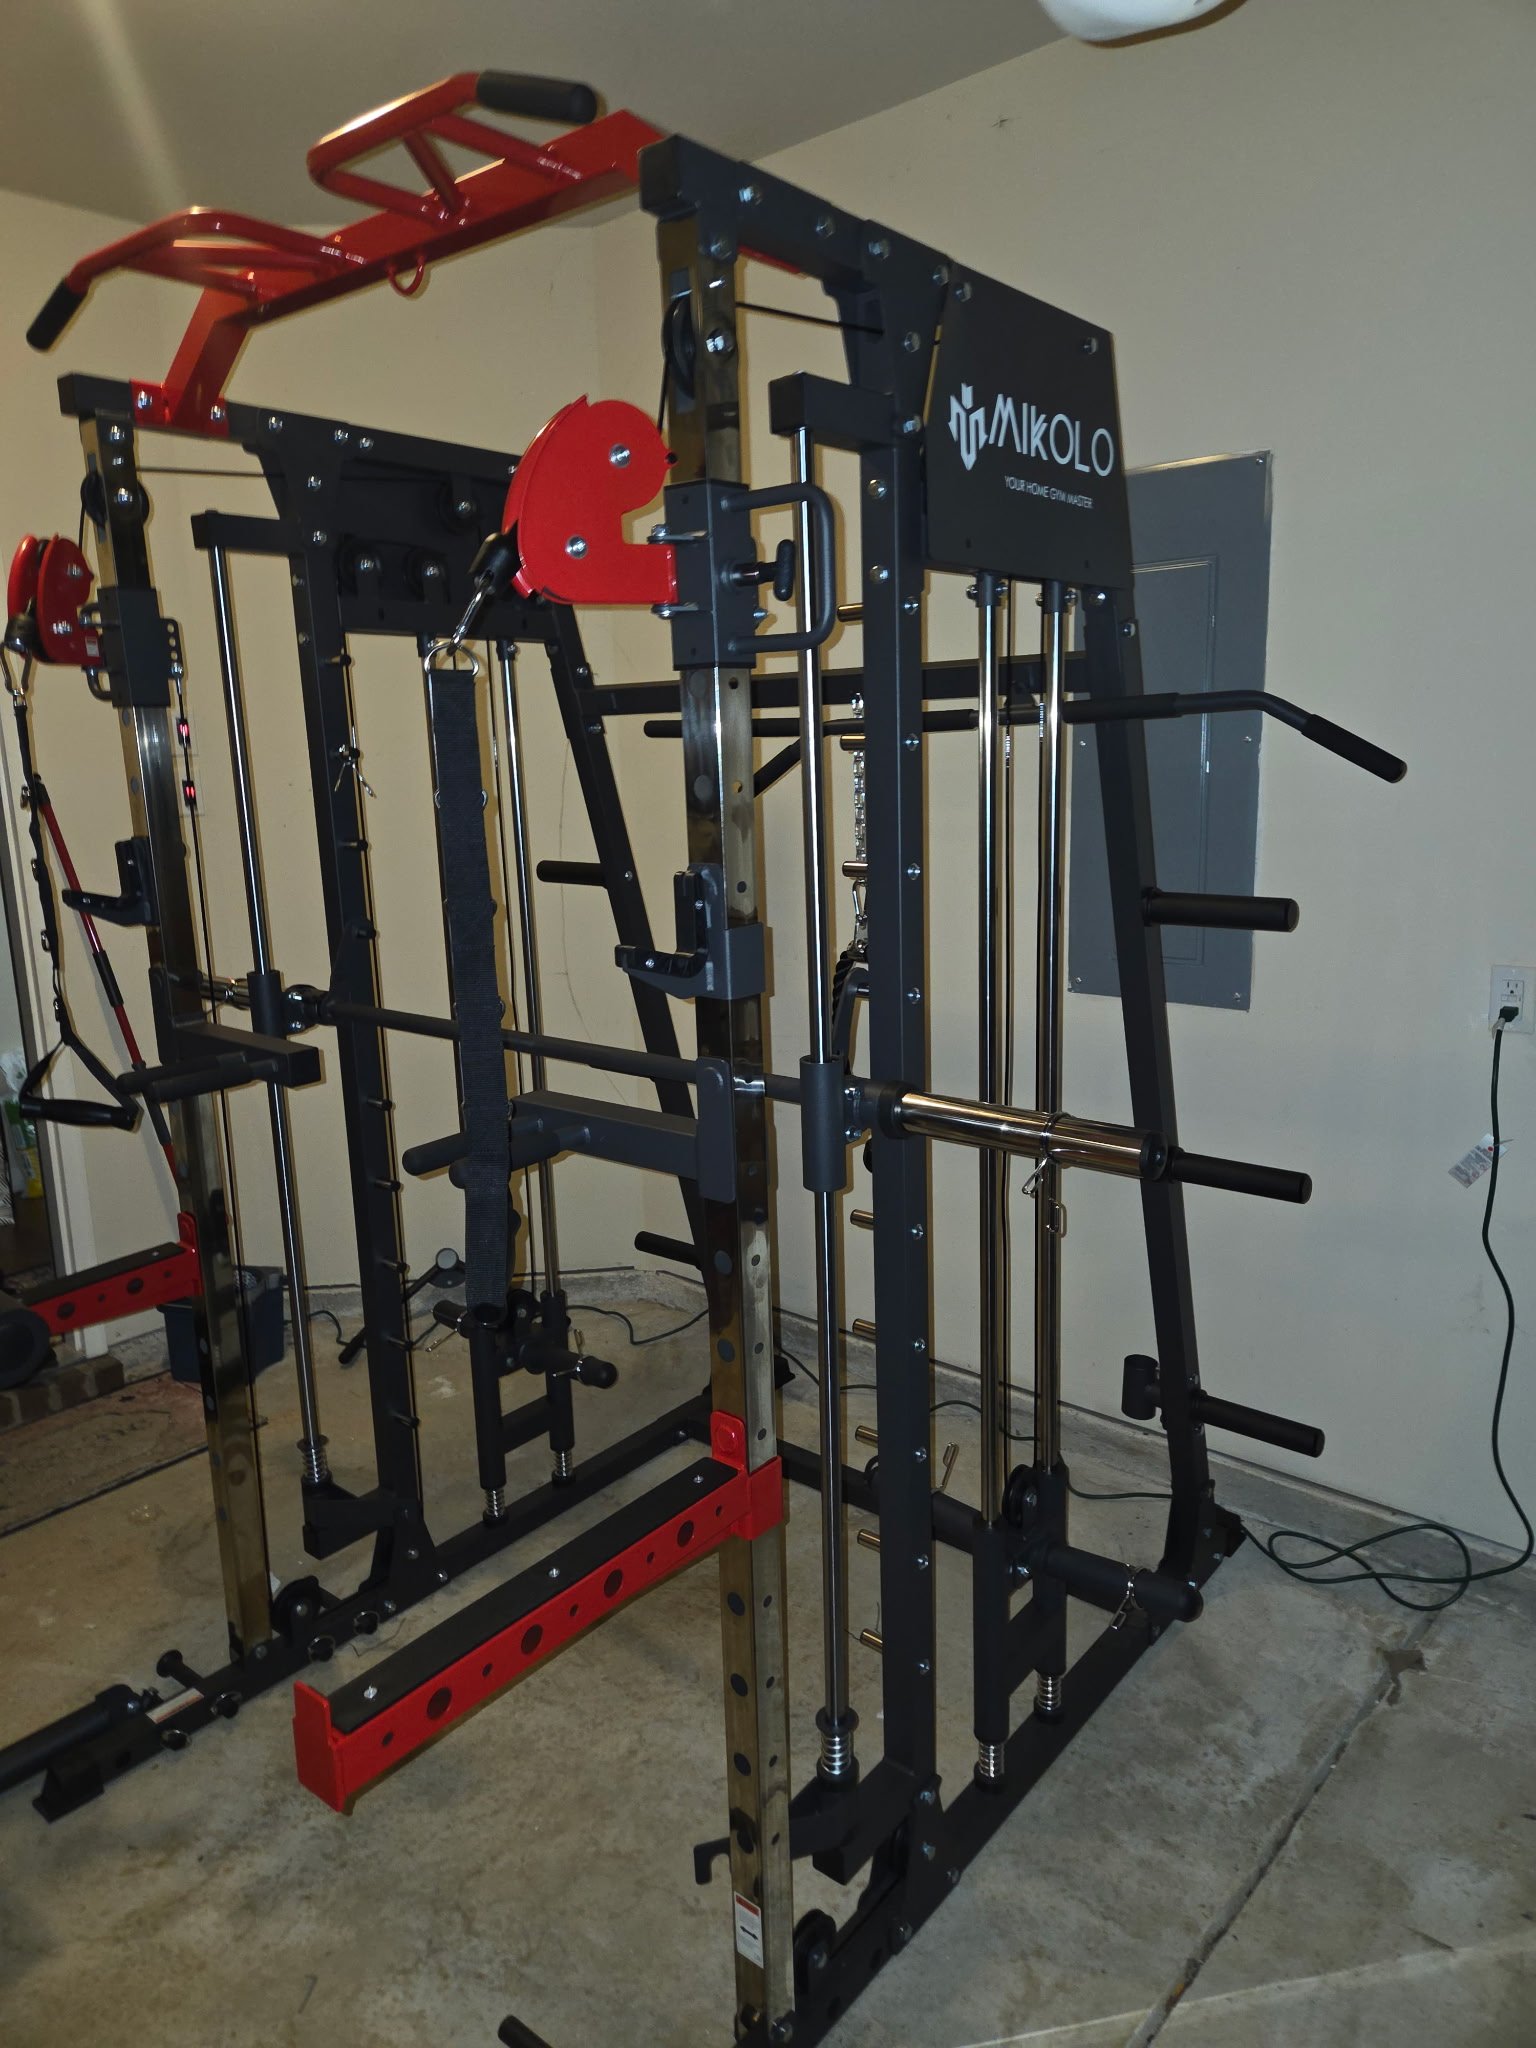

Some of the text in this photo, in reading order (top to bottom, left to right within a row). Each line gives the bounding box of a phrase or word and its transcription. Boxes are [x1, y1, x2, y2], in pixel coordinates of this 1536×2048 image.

[988, 393, 1115, 477] MIKOLO
[1004, 475, 1094, 509] YOUR HOME GYM MASTER
